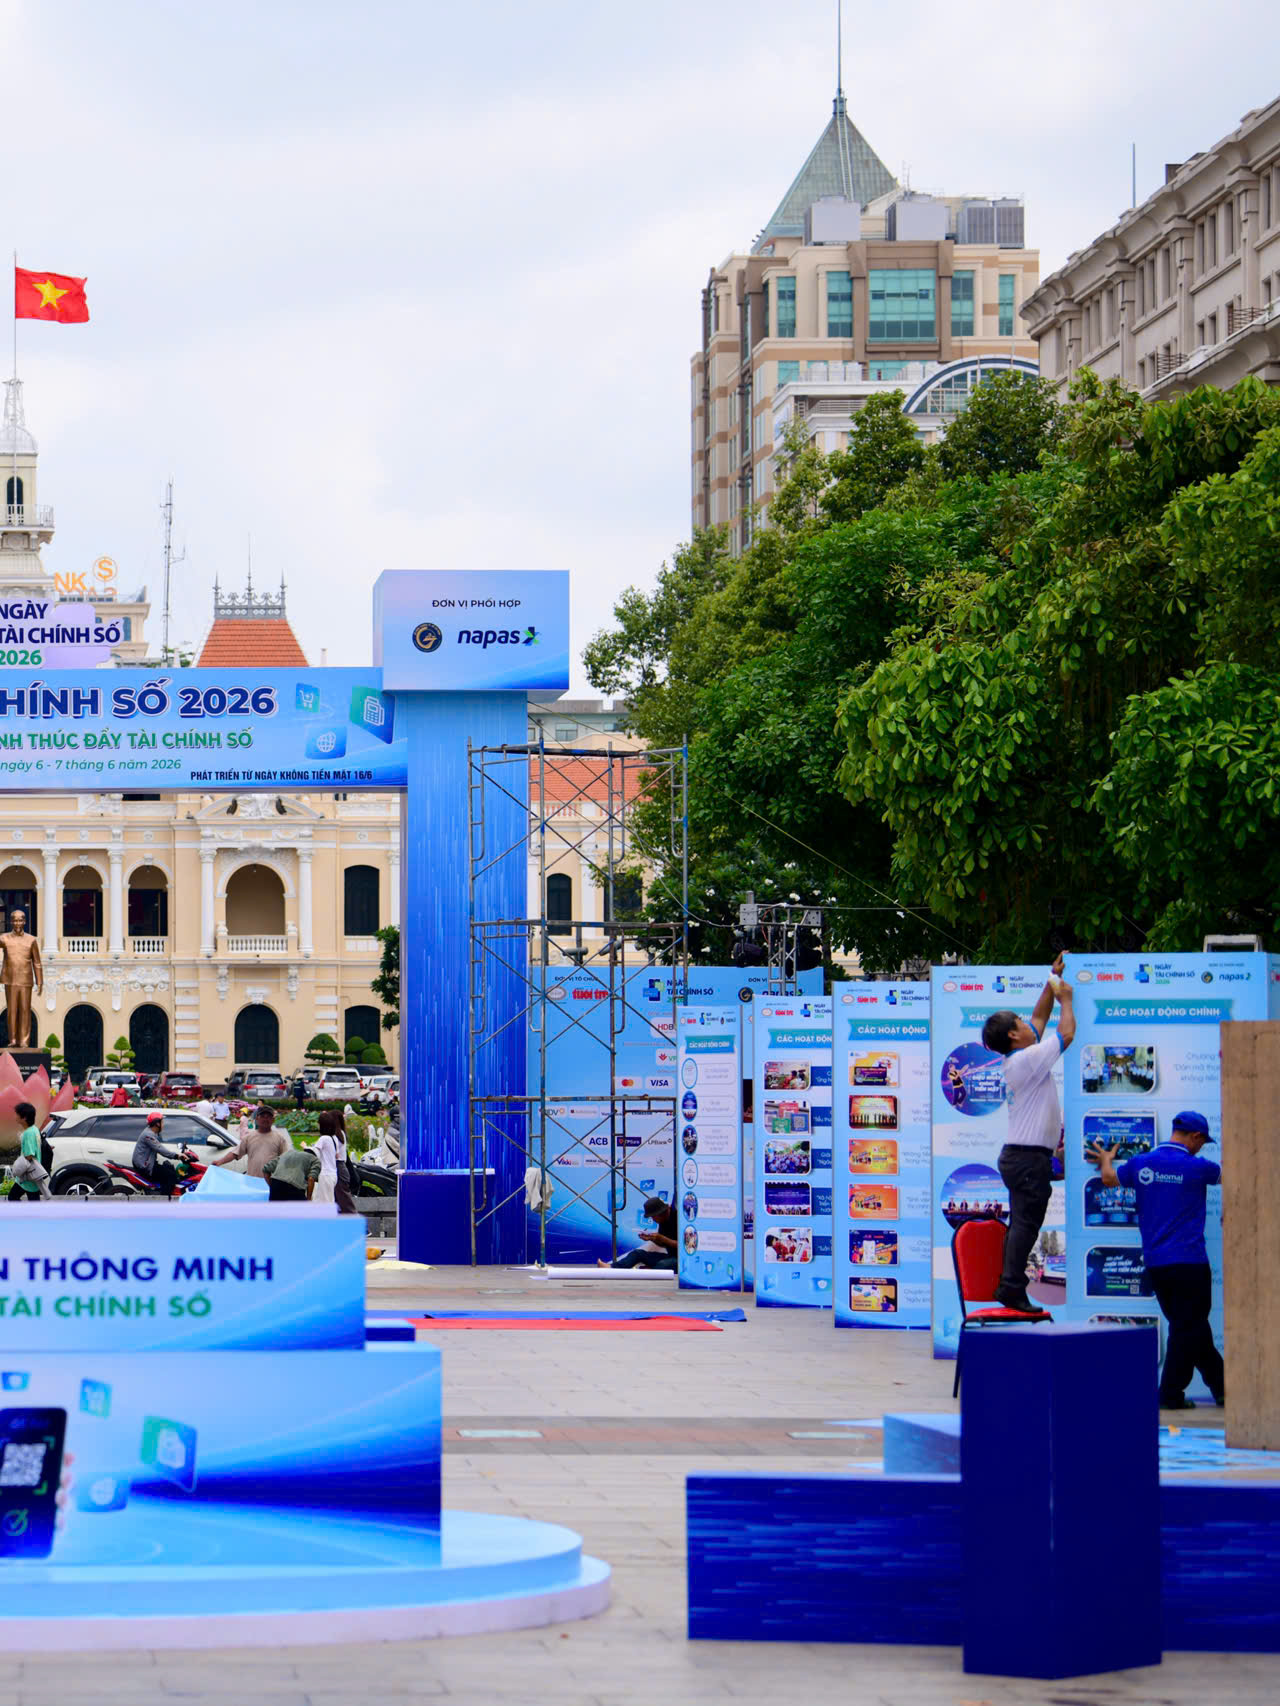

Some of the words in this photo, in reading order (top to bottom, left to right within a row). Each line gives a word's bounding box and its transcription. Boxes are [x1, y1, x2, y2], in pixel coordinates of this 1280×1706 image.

[432, 599, 455, 608] ĐƠN
[458, 599, 468, 610] VỊ
[470, 597, 496, 608] PHỐI
[499, 599, 521, 610] HỢP
[28, 624, 90, 644] CHÍNH
[94, 622, 120, 644] SỐ
[457, 629, 520, 649] napas
[111, 677, 172, 718] SỐ
[177, 686, 278, 718] 2026
[27, 729, 79, 749] THÚC
[83, 727, 123, 749] ĐẨY
[127, 729, 158, 748] TÀI
[161, 728, 222, 748] CHÍNH
[227, 727, 254, 748] SỐ
[0, 760, 33, 773] ngày
[35, 760, 44, 770] 6
[55, 760, 63, 770] 7
[65, 759, 103, 772] tháng
[107, 760, 116, 769] 6
[119, 760, 148, 770] năm
[151, 759, 182, 769] 2026
[190, 769, 212, 781] PHÁT
[215, 768, 240, 781] TRIỂN
[242, 769, 253, 780] TỪ
[254, 770, 278, 780] NGÀY
[280, 769, 309, 780] KHÔNG
[311, 768, 331, 780] TIỀN
[333, 769, 353, 782] MẶT
[354, 770, 372, 780] 16/6
[1219, 973, 1244, 982] napas
[1105, 1007, 1127, 1016] CÁC
[1130, 1008, 1155, 1018] HOẠT
[1158, 1007, 1186, 1018] ĐỘNG
[1189, 1006, 1220, 1016] CHÍNH
[858, 1025, 877, 1033] CÁC
[879, 1027, 900, 1035] HOẠT
[902, 1026, 927, 1036] ĐỘNG
[816, 1035, 832, 1043] ĐỘN
[589, 1137, 608, 1145] ACB
[24, 1252, 158, 1282] THÔNG
[173, 1257, 274, 1282] MINH
[54, 1289, 156, 1318] CHÍNH
[170, 1288, 211, 1317] SỐ
